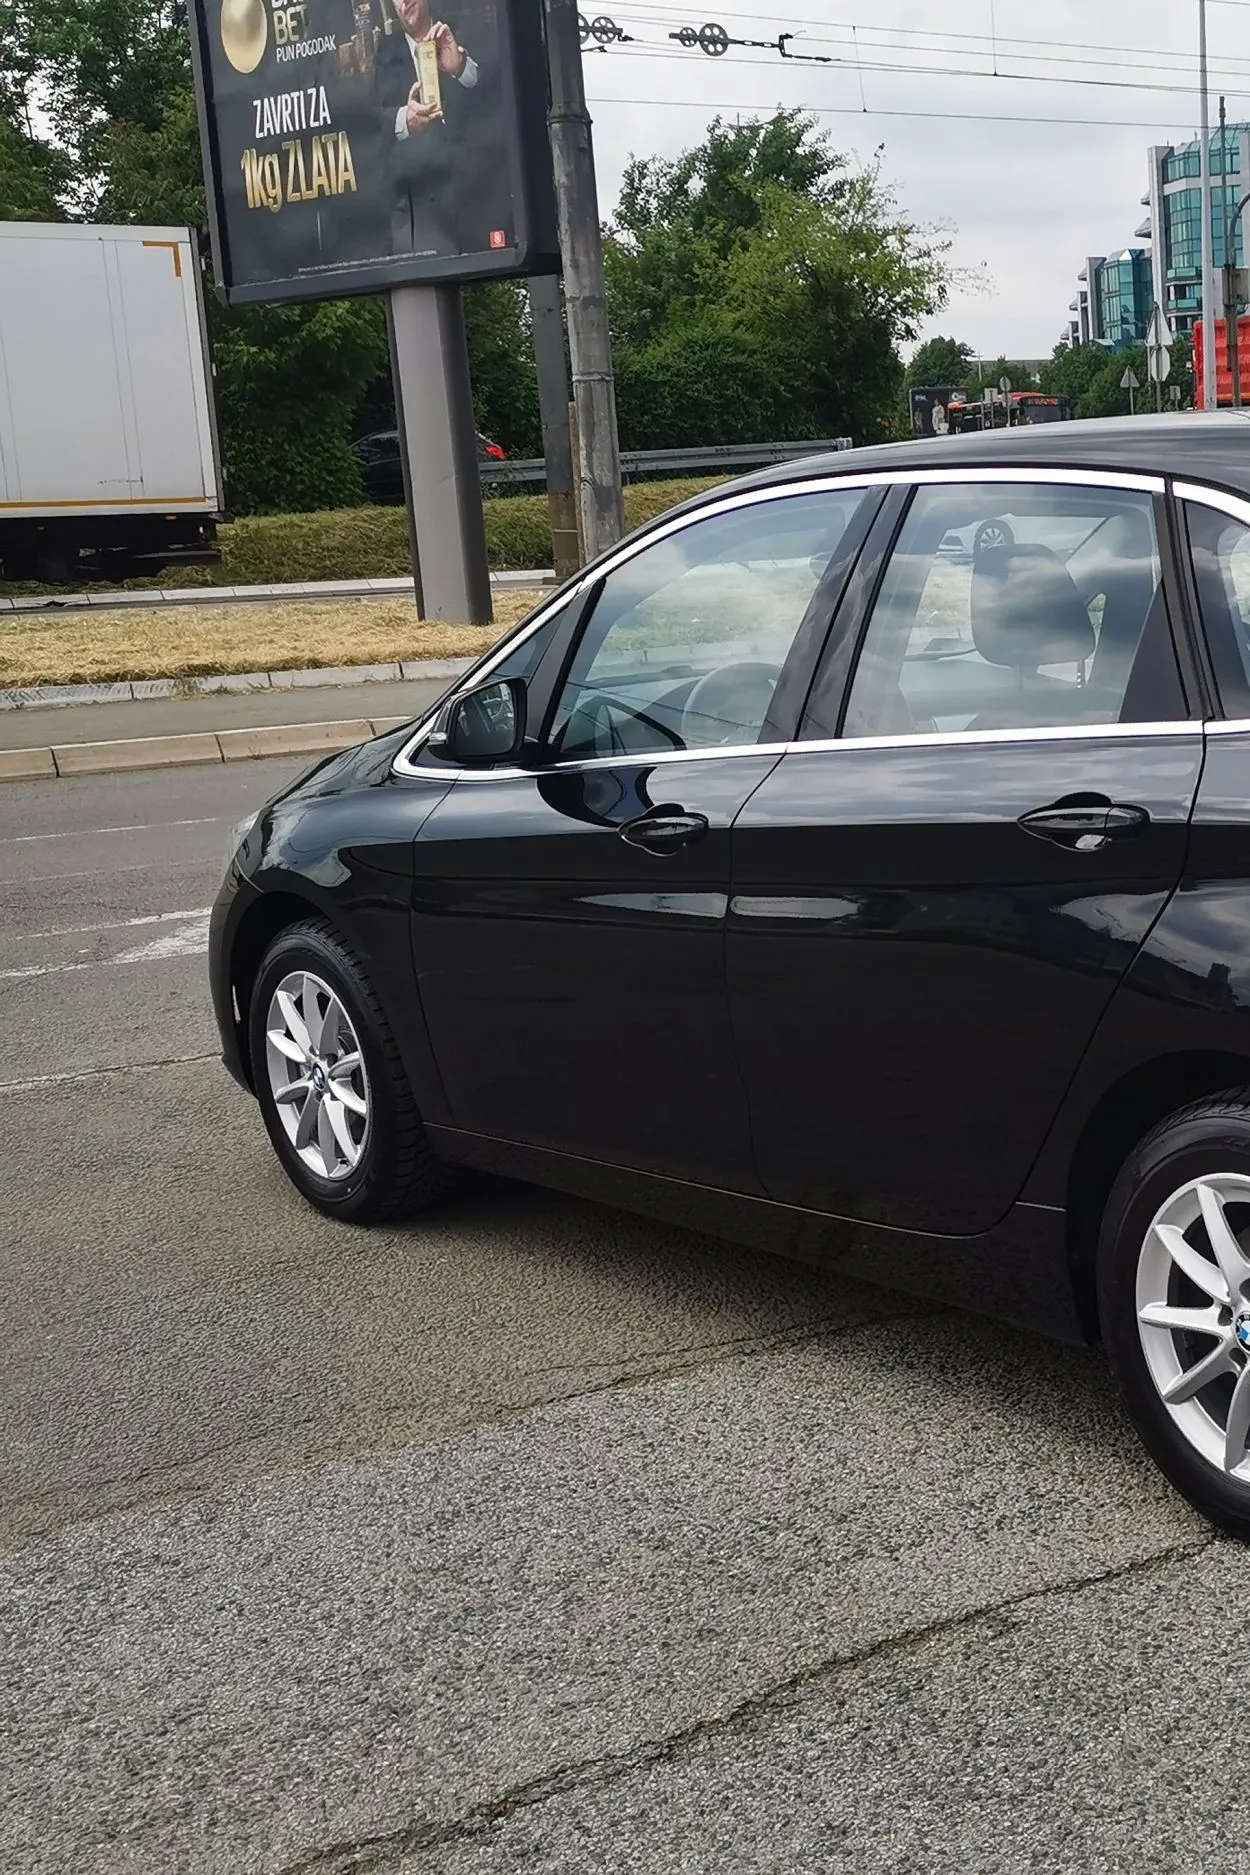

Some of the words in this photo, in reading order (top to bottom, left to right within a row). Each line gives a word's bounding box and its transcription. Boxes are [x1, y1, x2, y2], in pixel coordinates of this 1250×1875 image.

[276, 44, 296, 63] PUN
[296, 33, 337, 59] POGODAK
[252, 90, 307, 139] ZAVRTI
[307, 85, 332, 129] ZA
[241, 148, 283, 214] 1kg
[281, 130, 358, 203] ZLATA
